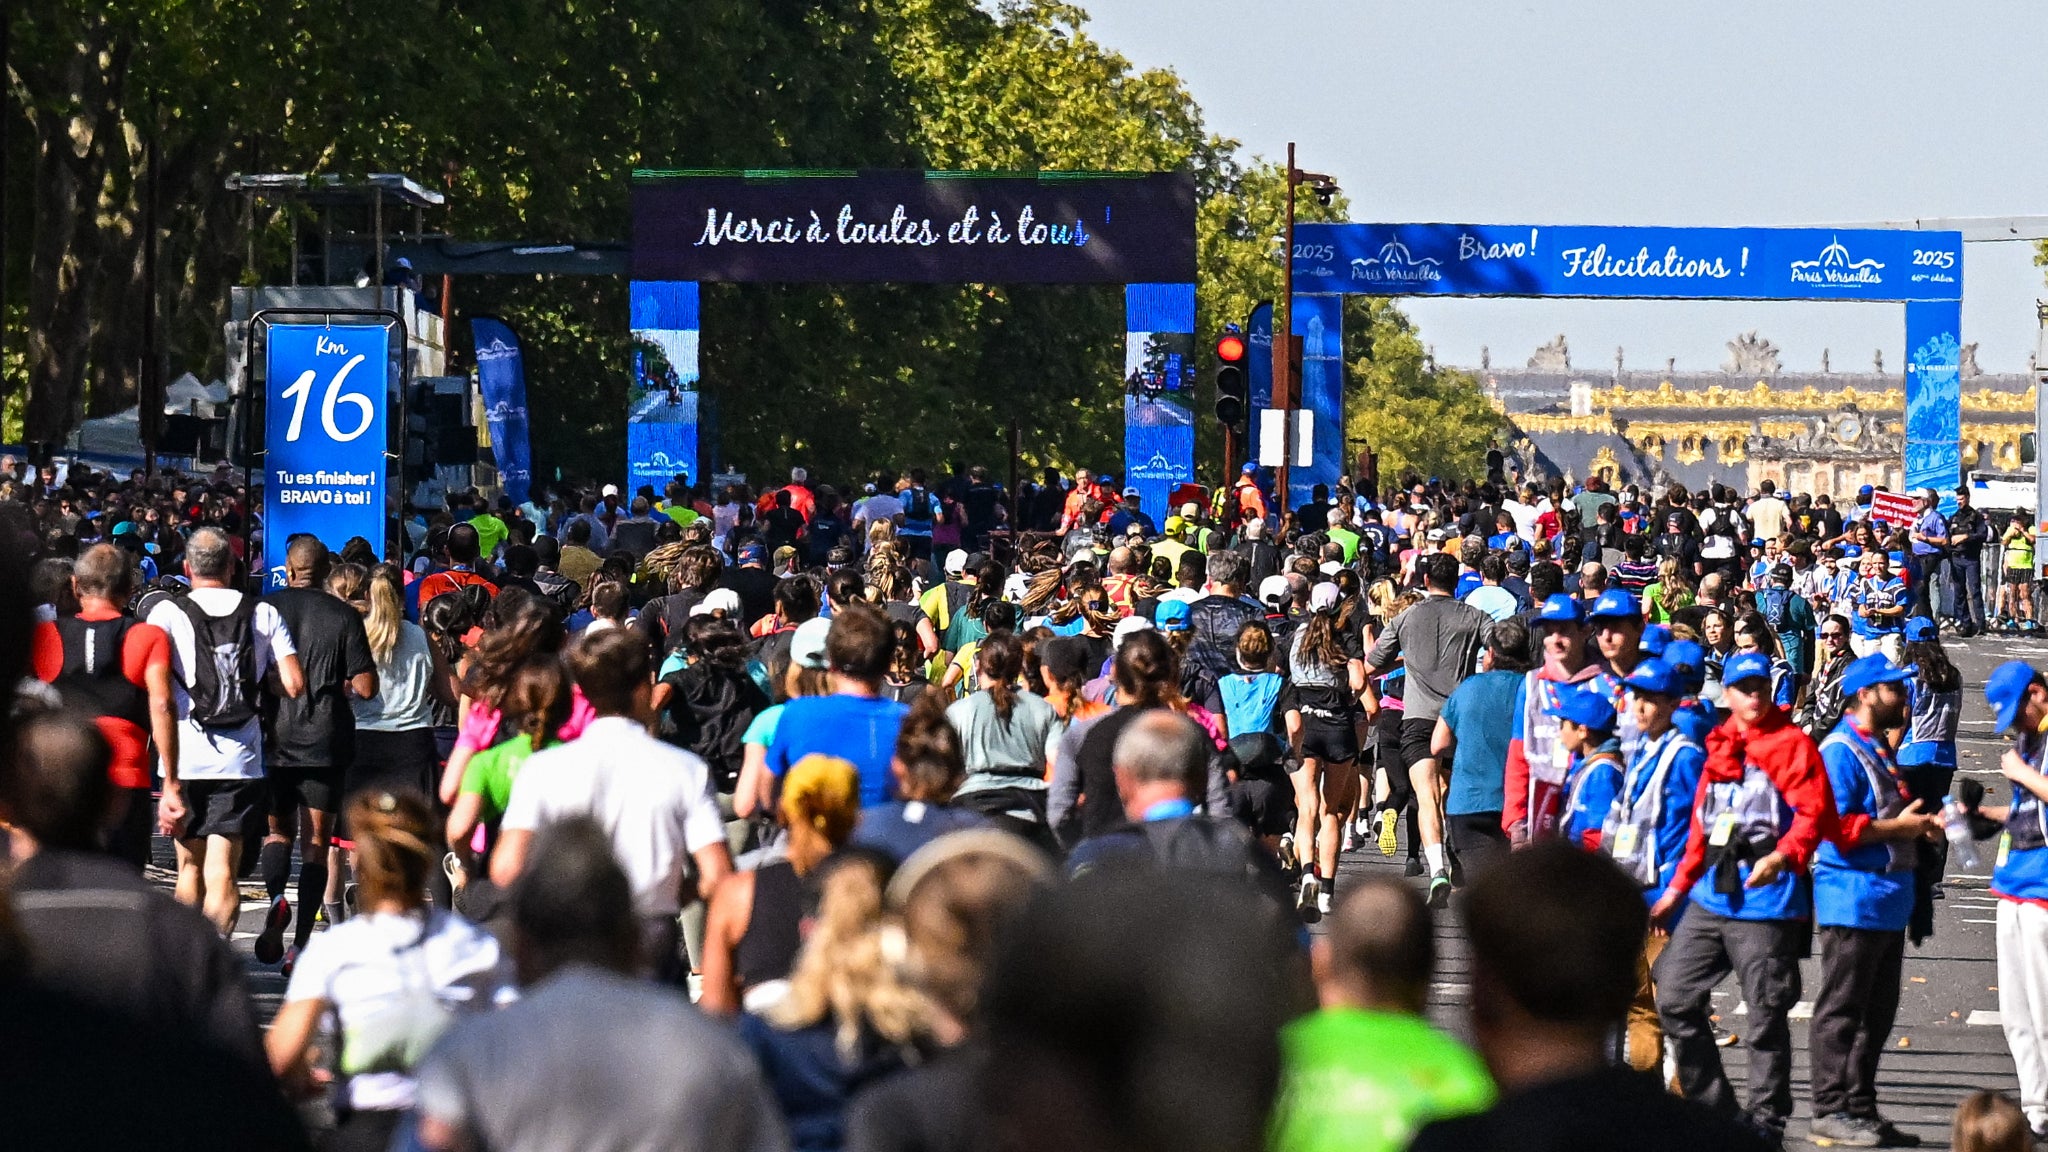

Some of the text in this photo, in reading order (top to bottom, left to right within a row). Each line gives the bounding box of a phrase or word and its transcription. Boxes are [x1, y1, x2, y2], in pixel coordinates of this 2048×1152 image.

[693, 207, 801, 246] Merci
[806, 209, 830, 244] à
[837, 204, 940, 246] toutes
[949, 205, 982, 245] et
[987, 209, 1011, 244] à
[1018, 204, 1090, 247] tous
[1292, 244, 1335, 262] 2025
[1562, 243, 1749, 279] Félicitations !
[1912, 248, 1955, 269] 2025
[1351, 266, 1382, 281] Paris
[1383, 264, 1442, 282] Versailles
[1791, 266, 1883, 284] Paris Versailles
[315, 335, 349, 357] Km
[281, 353, 375, 443] 16
[276, 470, 294, 485] Tu
[296, 474, 314, 485] es
[315, 470, 369, 486] finisher
[280, 490, 332, 504] BRAVO
[334, 490, 342, 505] à
[345, 492, 365, 505] toi
